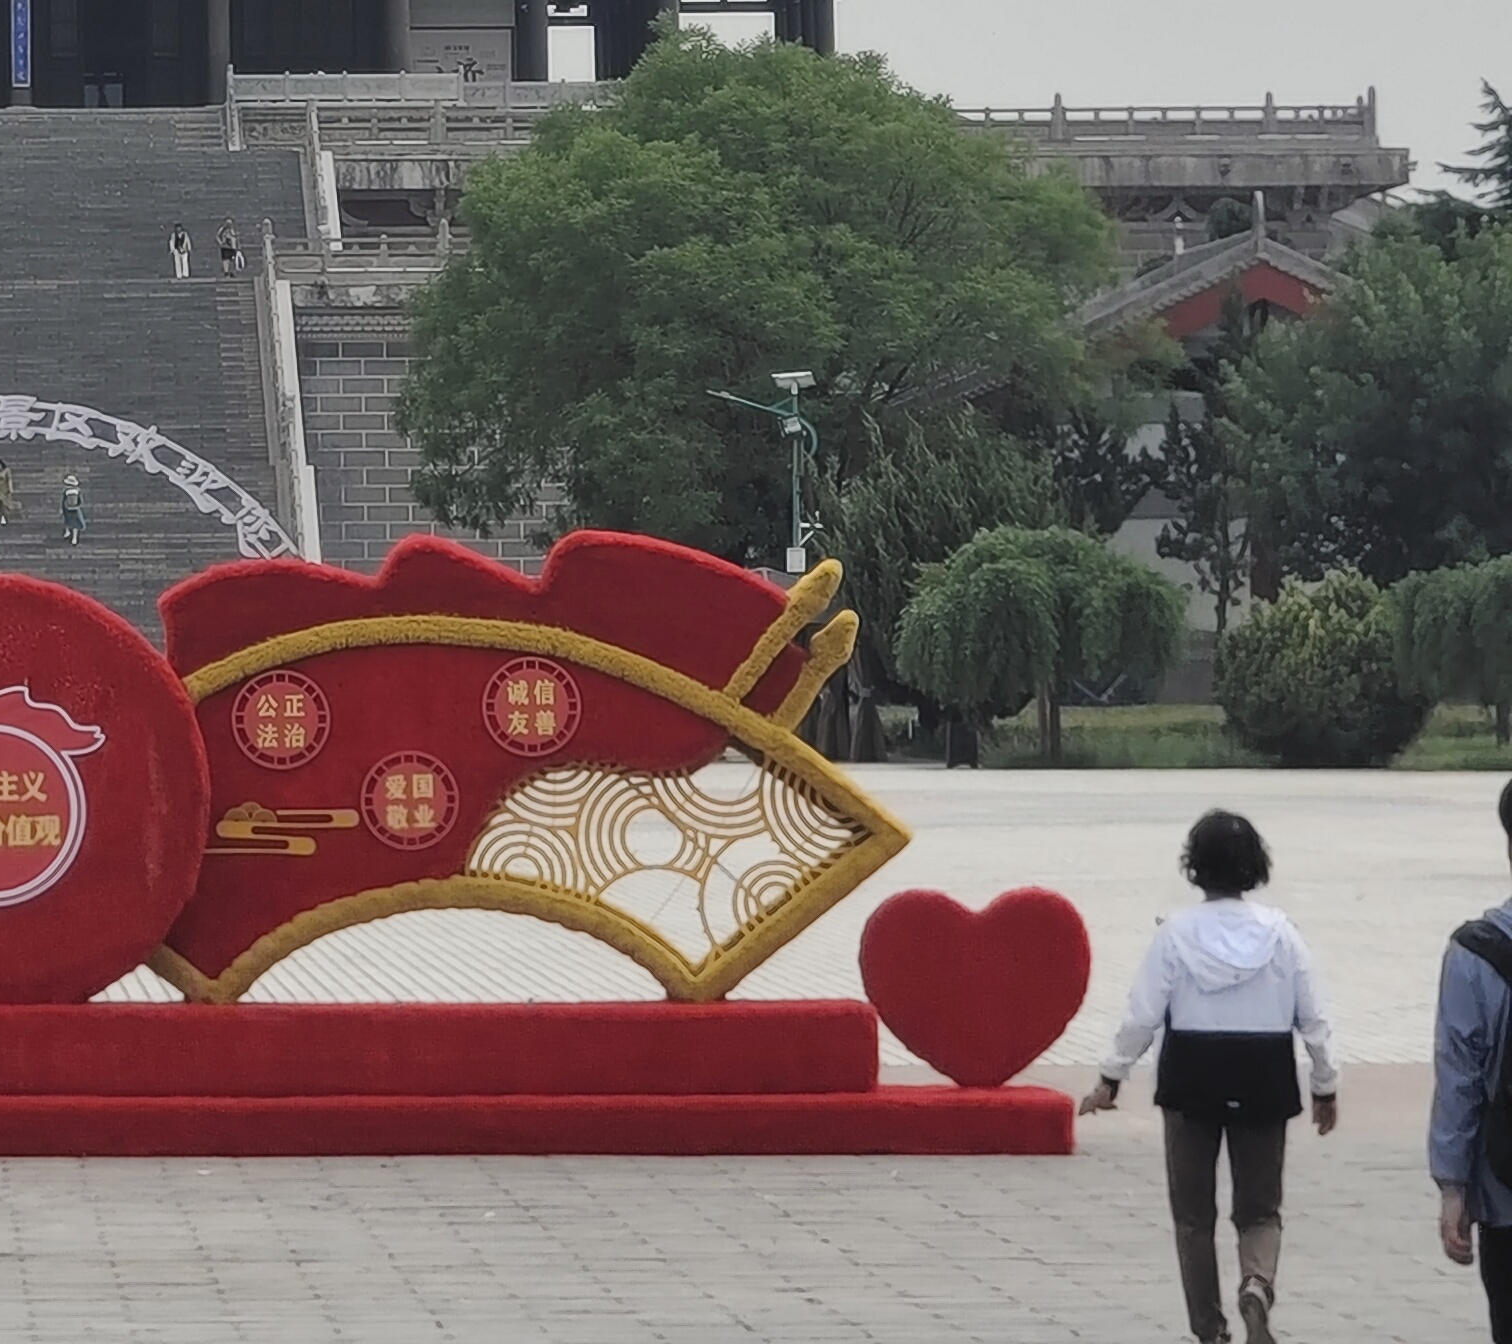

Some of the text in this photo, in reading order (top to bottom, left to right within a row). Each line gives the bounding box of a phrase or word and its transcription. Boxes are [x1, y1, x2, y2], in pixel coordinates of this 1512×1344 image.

[506, 678, 556, 706] 诚信
[256, 693, 306, 719] 公正
[256, 722, 307, 749] 法治
[507, 709, 557, 736] 友善
[384, 773, 435, 800] 爱国
[385, 804, 436, 831] 敬业
